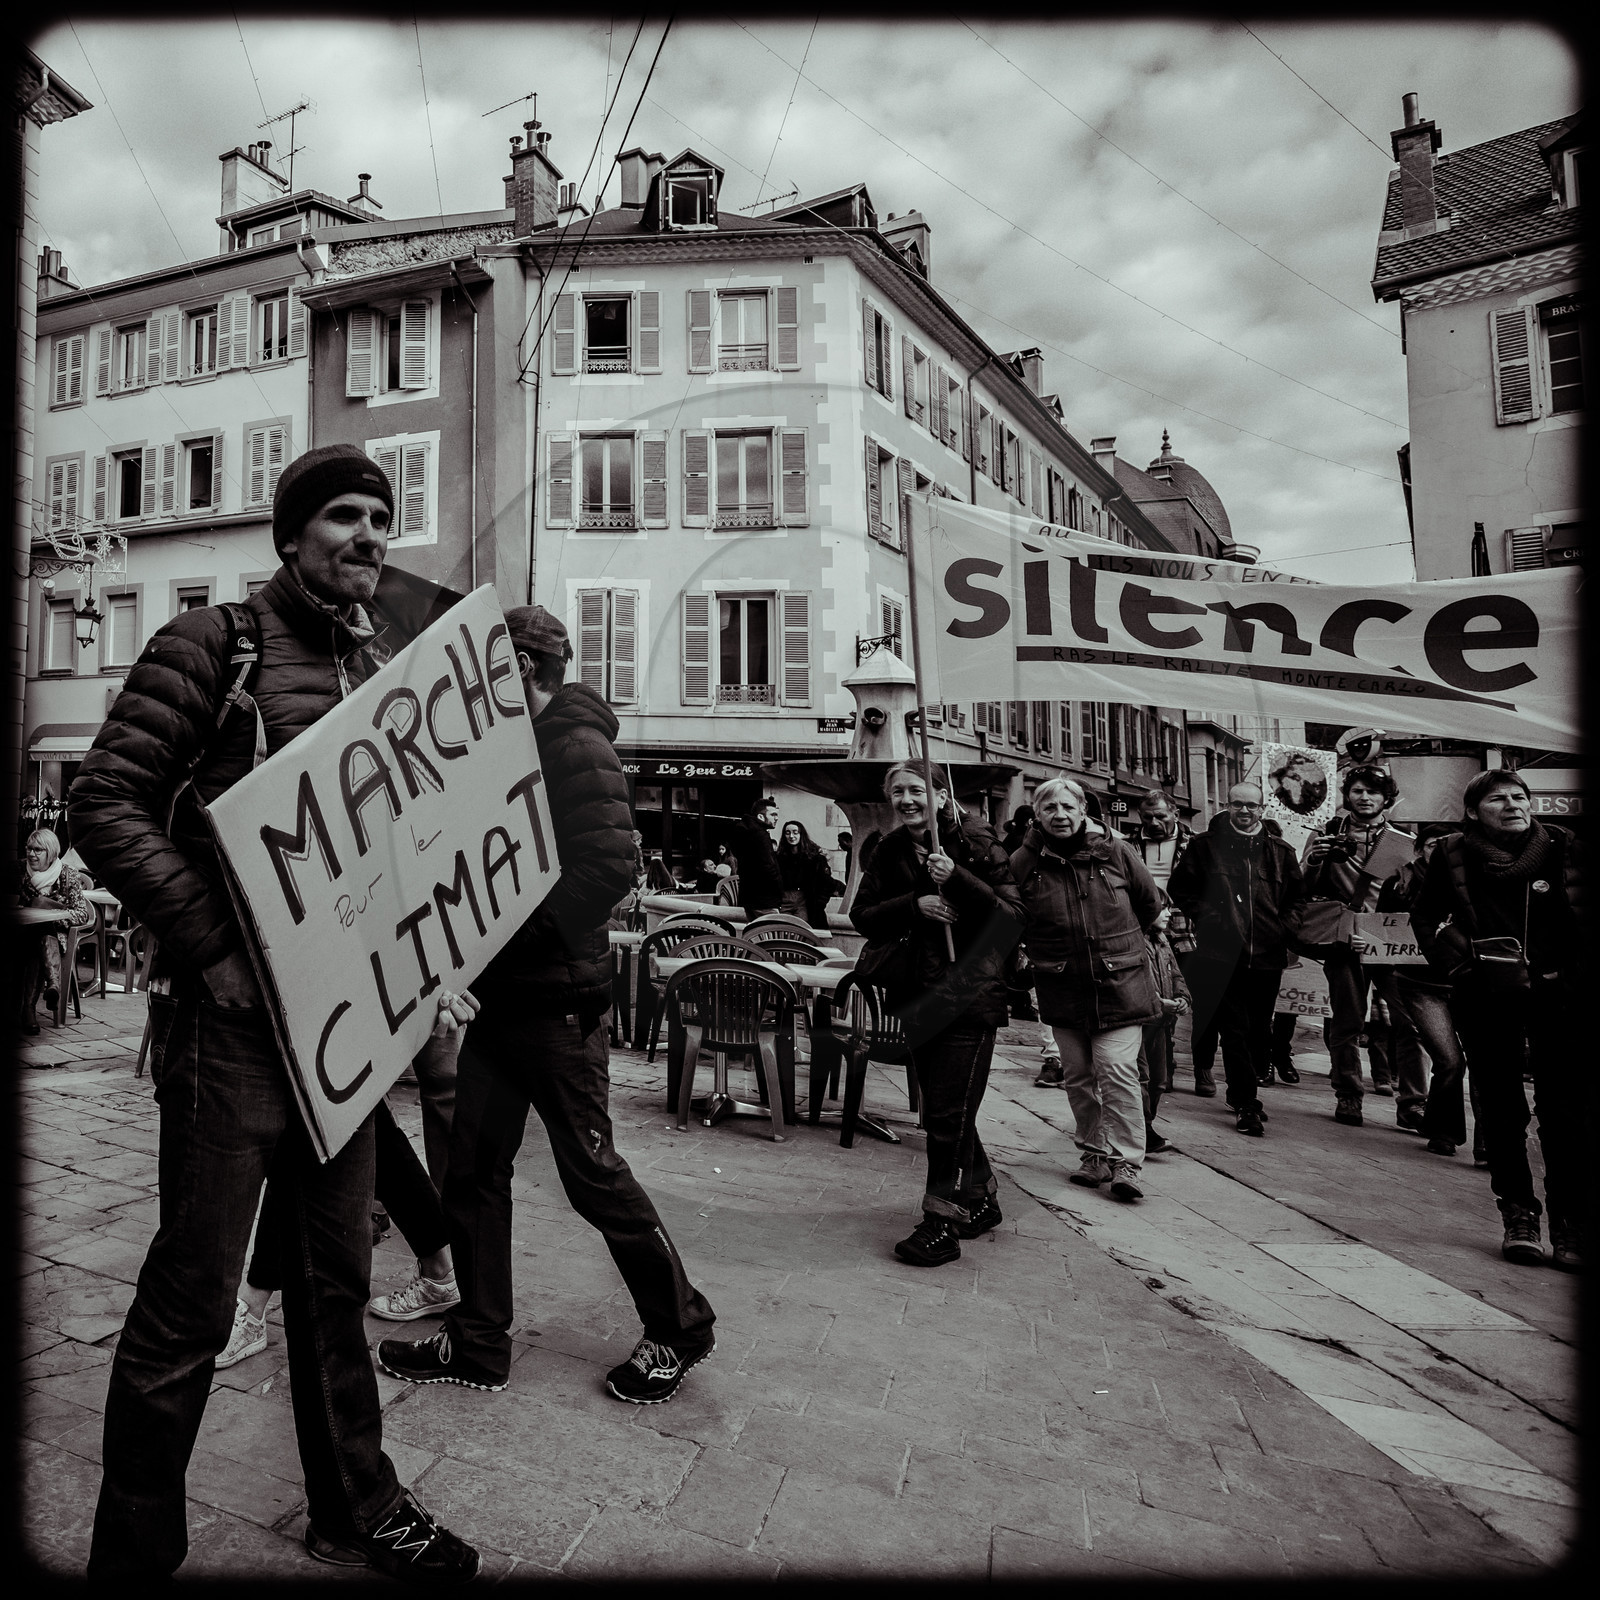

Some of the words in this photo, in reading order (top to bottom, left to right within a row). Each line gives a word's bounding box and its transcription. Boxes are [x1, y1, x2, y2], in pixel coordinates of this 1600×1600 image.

[1039, 525, 1070, 539] AU
[1097, 555, 1135, 573] ILS
[1149, 558, 1220, 582] NOUS
[944, 542, 1541, 693] silence
[1281, 669, 1347, 689] MONTE
[1356, 678, 1427, 694] CARLO
[260, 623, 526, 926] MARCHE
[655, 763, 680, 775] Le
[721, 764, 754, 777] Eat
[410, 824, 442, 857] le
[333, 872, 384, 933] Pour
[1383, 916, 1398, 927] LE
[315, 768, 551, 1105] CLIMAT
[1363, 943, 1378, 957] LA
[1278, 987, 1316, 1003] CÔTÉ
[1289, 1001, 1330, 1016] FORCE
